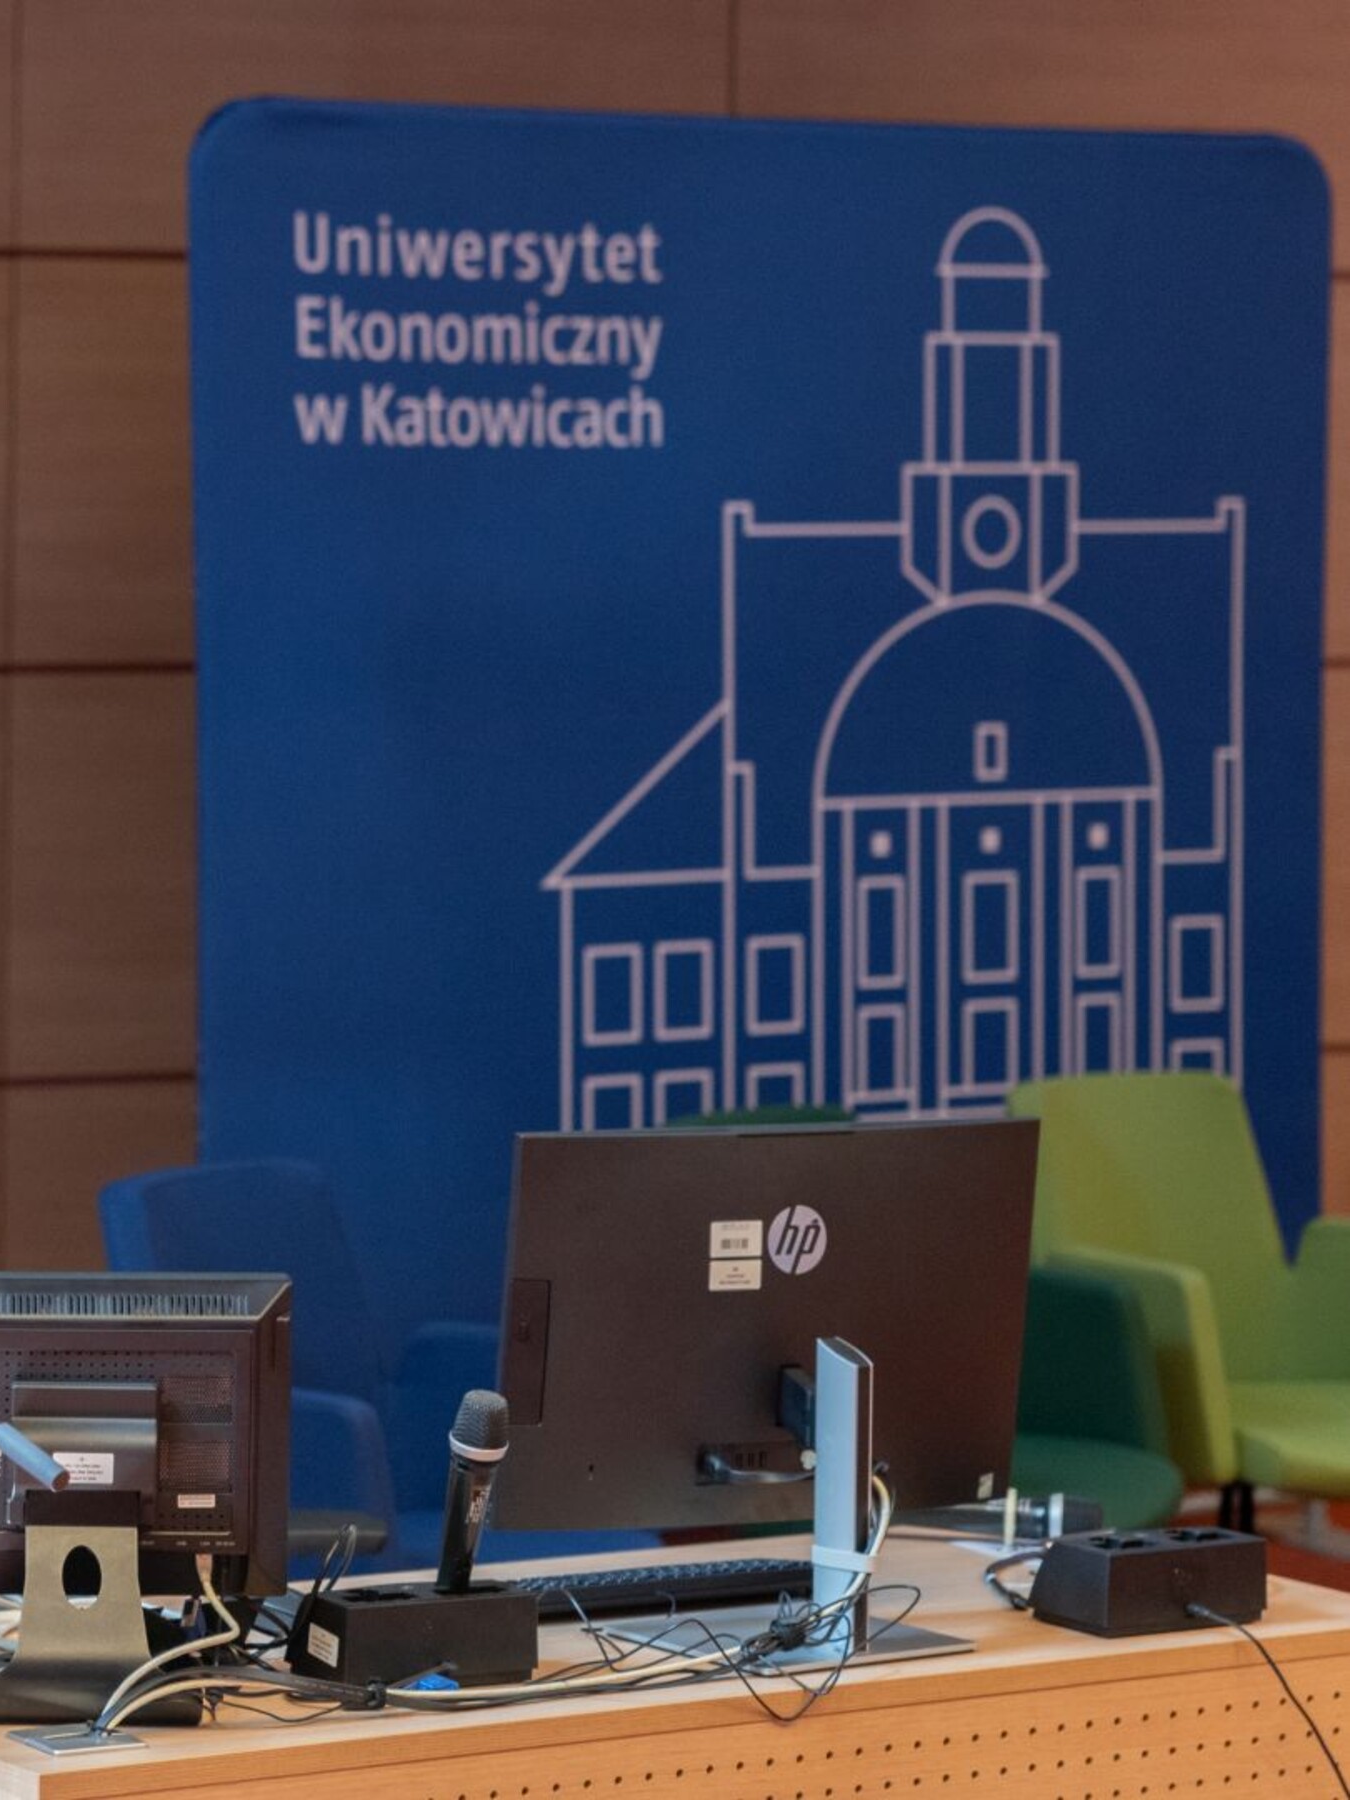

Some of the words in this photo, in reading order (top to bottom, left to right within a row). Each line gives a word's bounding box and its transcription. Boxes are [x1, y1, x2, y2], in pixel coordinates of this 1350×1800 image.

[293, 210, 663, 298] Uniwersytet
[294, 294, 663, 381] Ekonomiczny
[293, 393, 348, 446] w
[360, 382, 665, 449] Katowicach
[774, 1205, 821, 1275] hp
